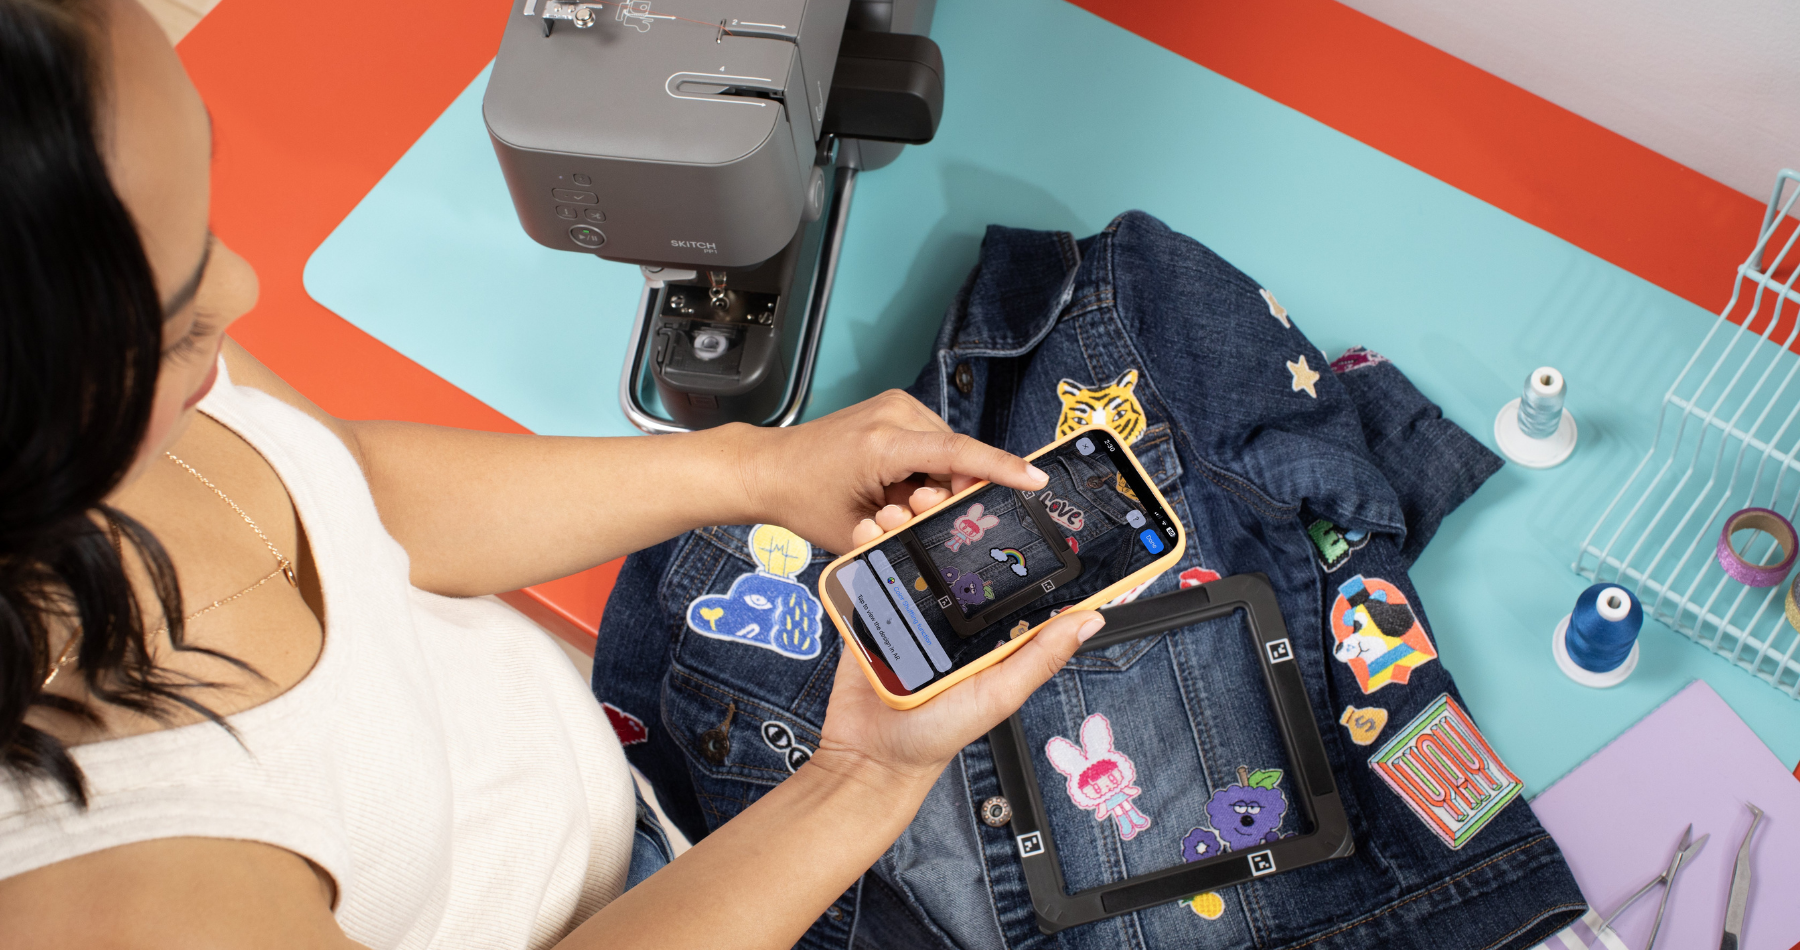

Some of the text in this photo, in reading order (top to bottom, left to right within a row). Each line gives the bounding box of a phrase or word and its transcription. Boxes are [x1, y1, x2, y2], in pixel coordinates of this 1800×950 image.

[732, 18, 738, 26] 2
[670, 239, 717, 250] SKITCH
[1104, 439, 1116, 452] 2:30
[1145, 534, 1157, 549] Done
[893, 586, 932, 646] Color Shuffling function
[863, 603, 869, 611] to
[867, 610, 875, 622] view
[879, 630, 892, 647] design
[893, 652, 901, 661] AR
